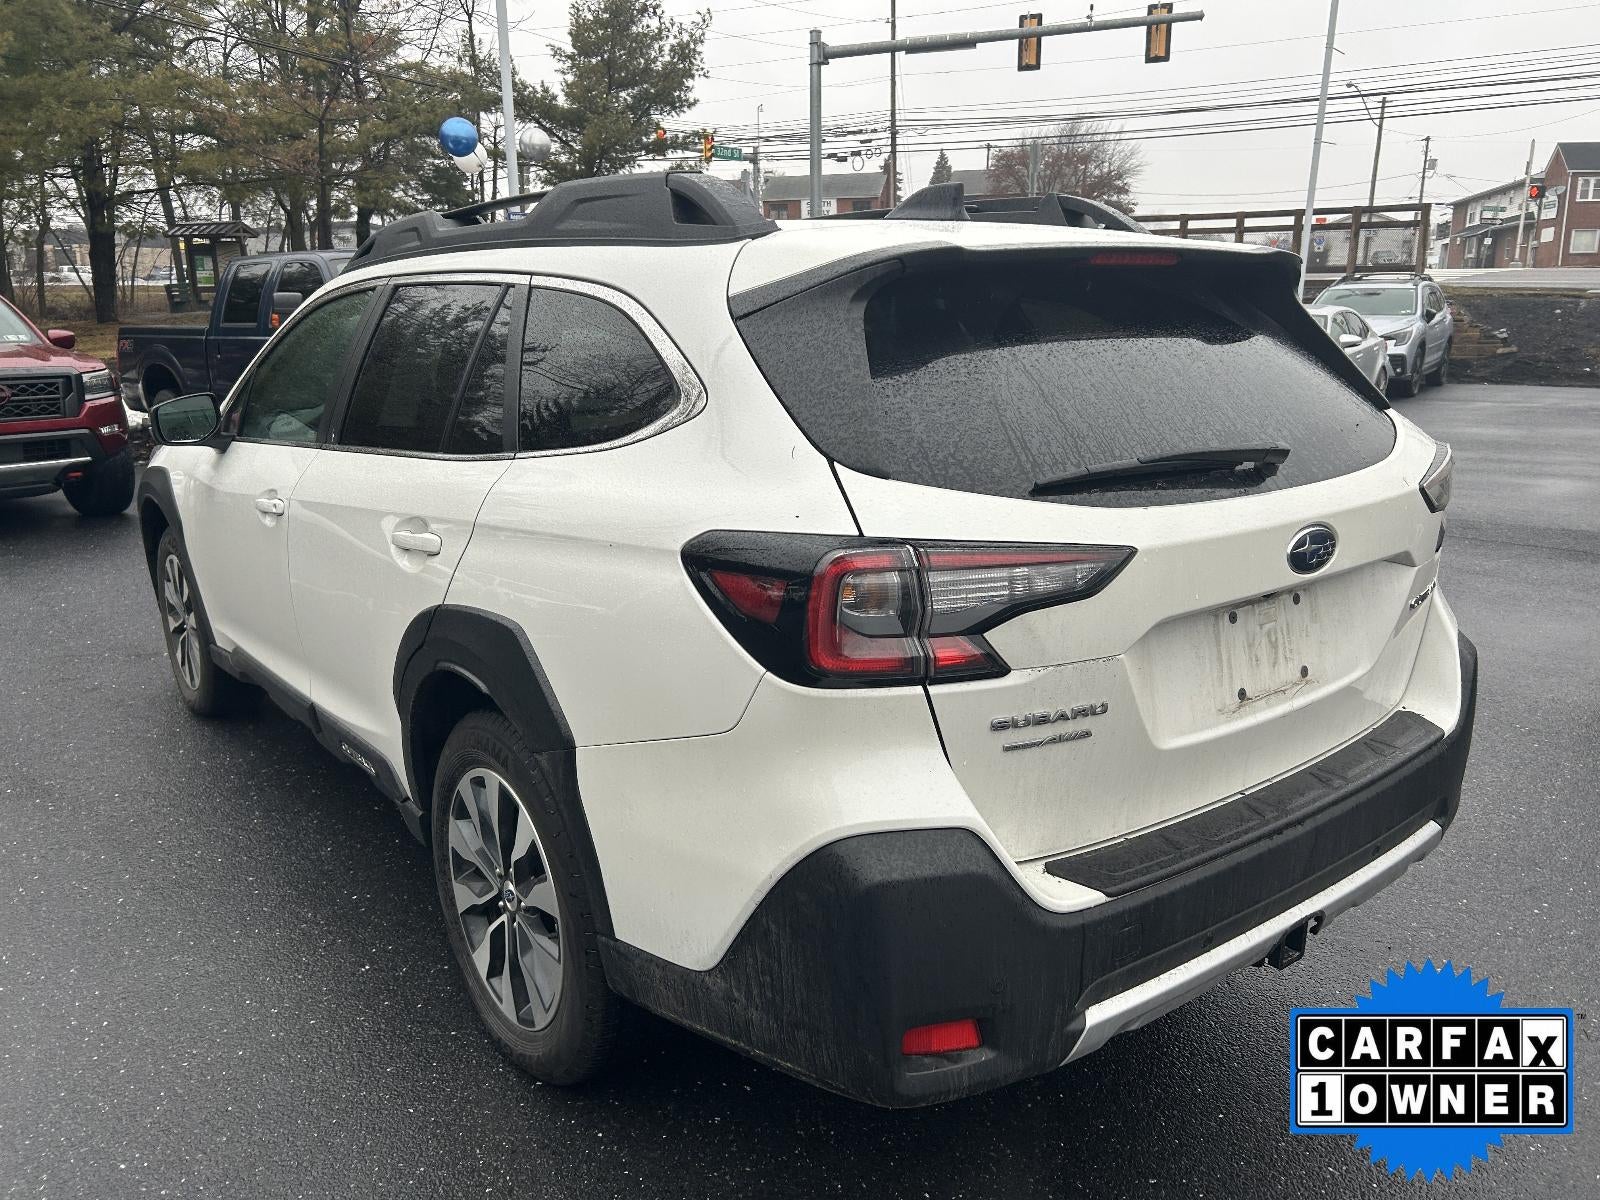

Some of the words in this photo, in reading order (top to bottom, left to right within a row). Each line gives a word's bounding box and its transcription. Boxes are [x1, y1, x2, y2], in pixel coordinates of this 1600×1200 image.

[716, 147, 731, 157] 32nd
[806, 200, 832, 208] STH
[990, 701, 1109, 732] SUBARU
